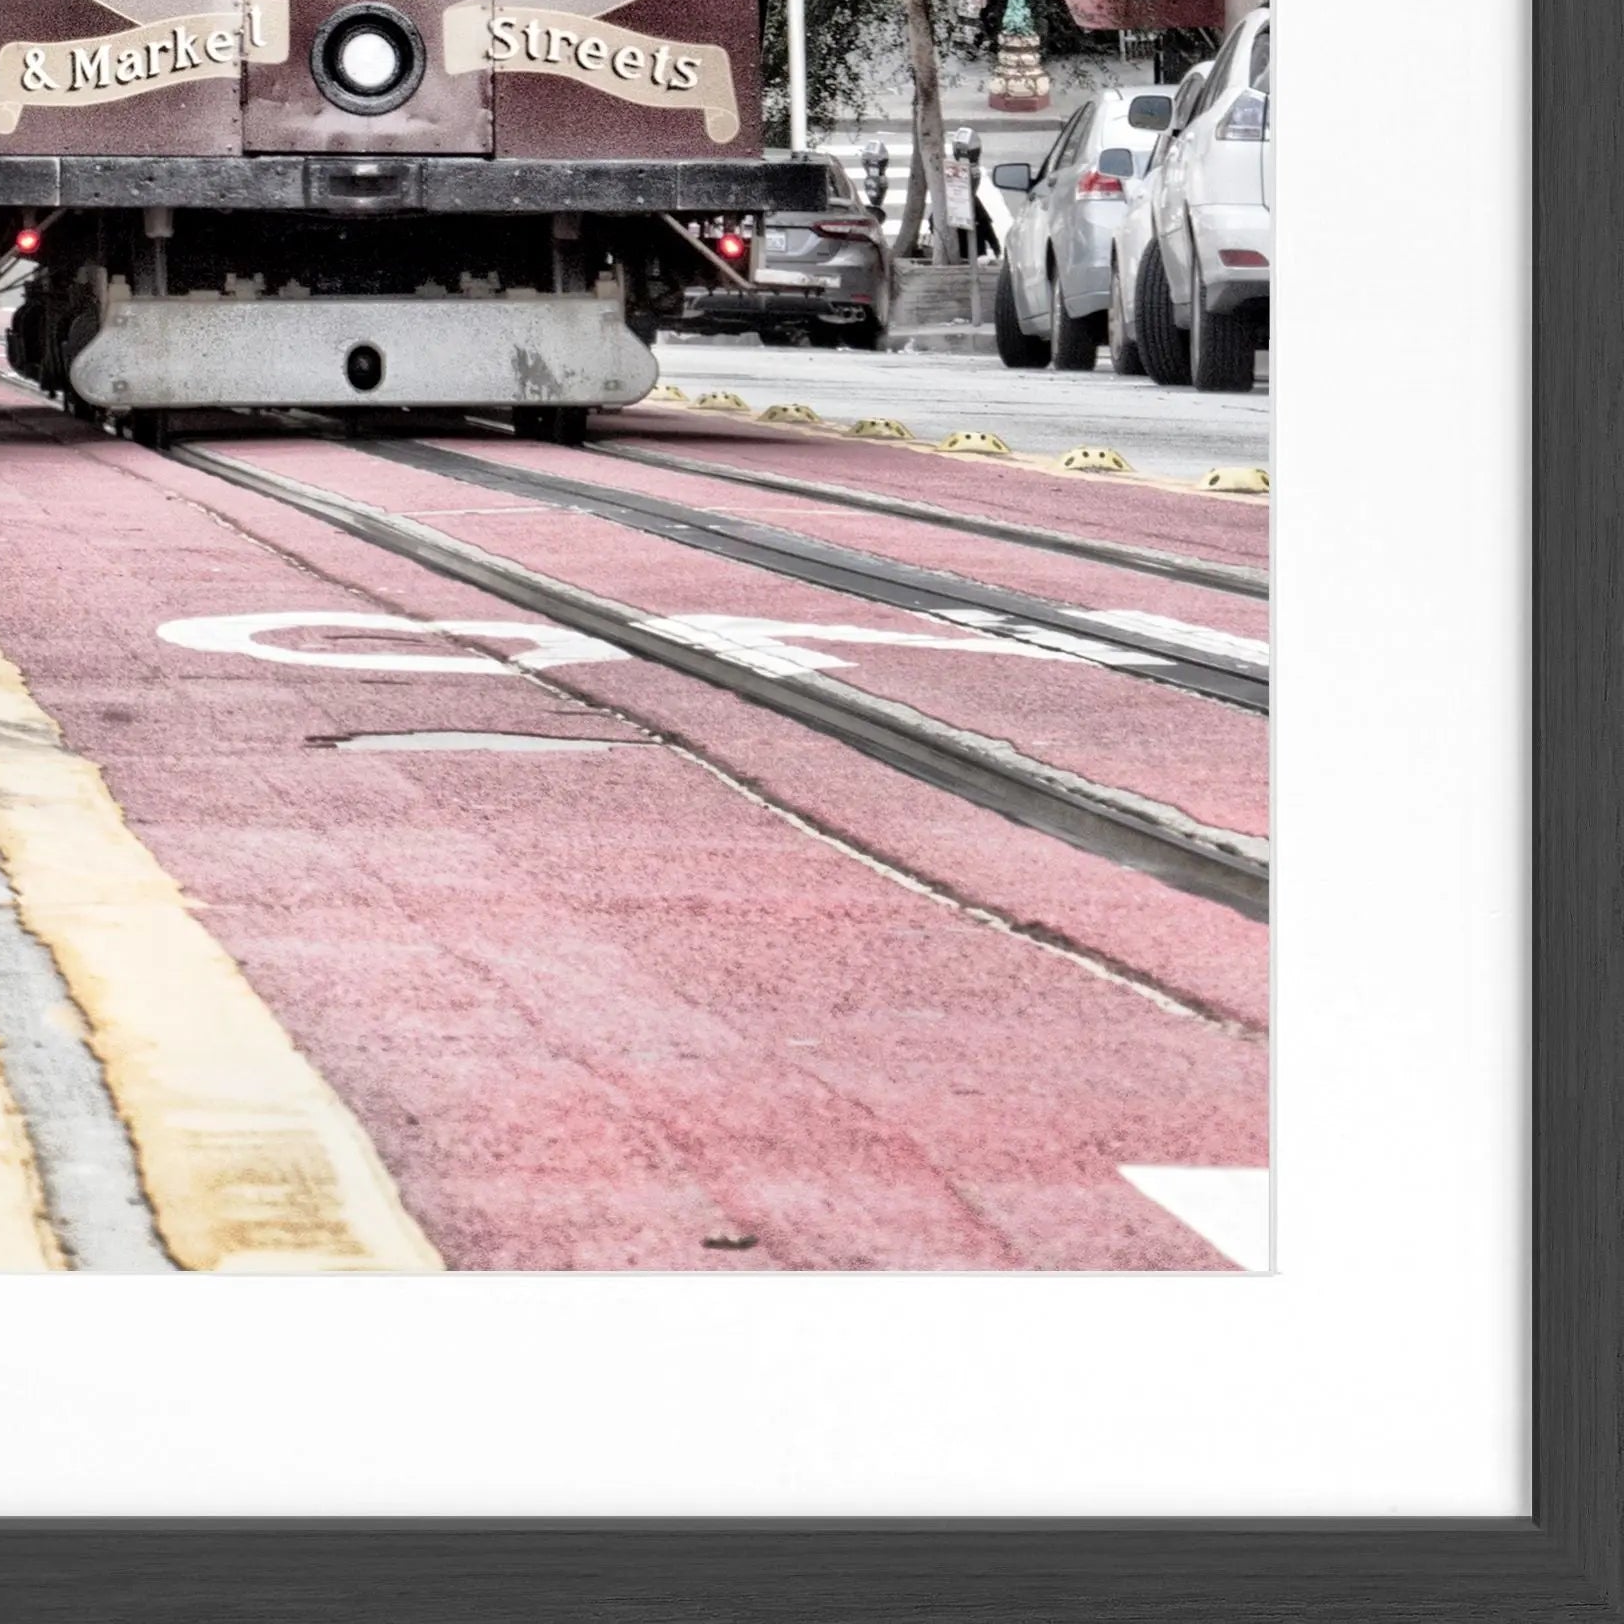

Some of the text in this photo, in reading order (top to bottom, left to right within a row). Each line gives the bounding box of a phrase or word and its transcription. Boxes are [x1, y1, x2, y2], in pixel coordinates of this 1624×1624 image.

[22, 5, 702, 93] & Market Streets
